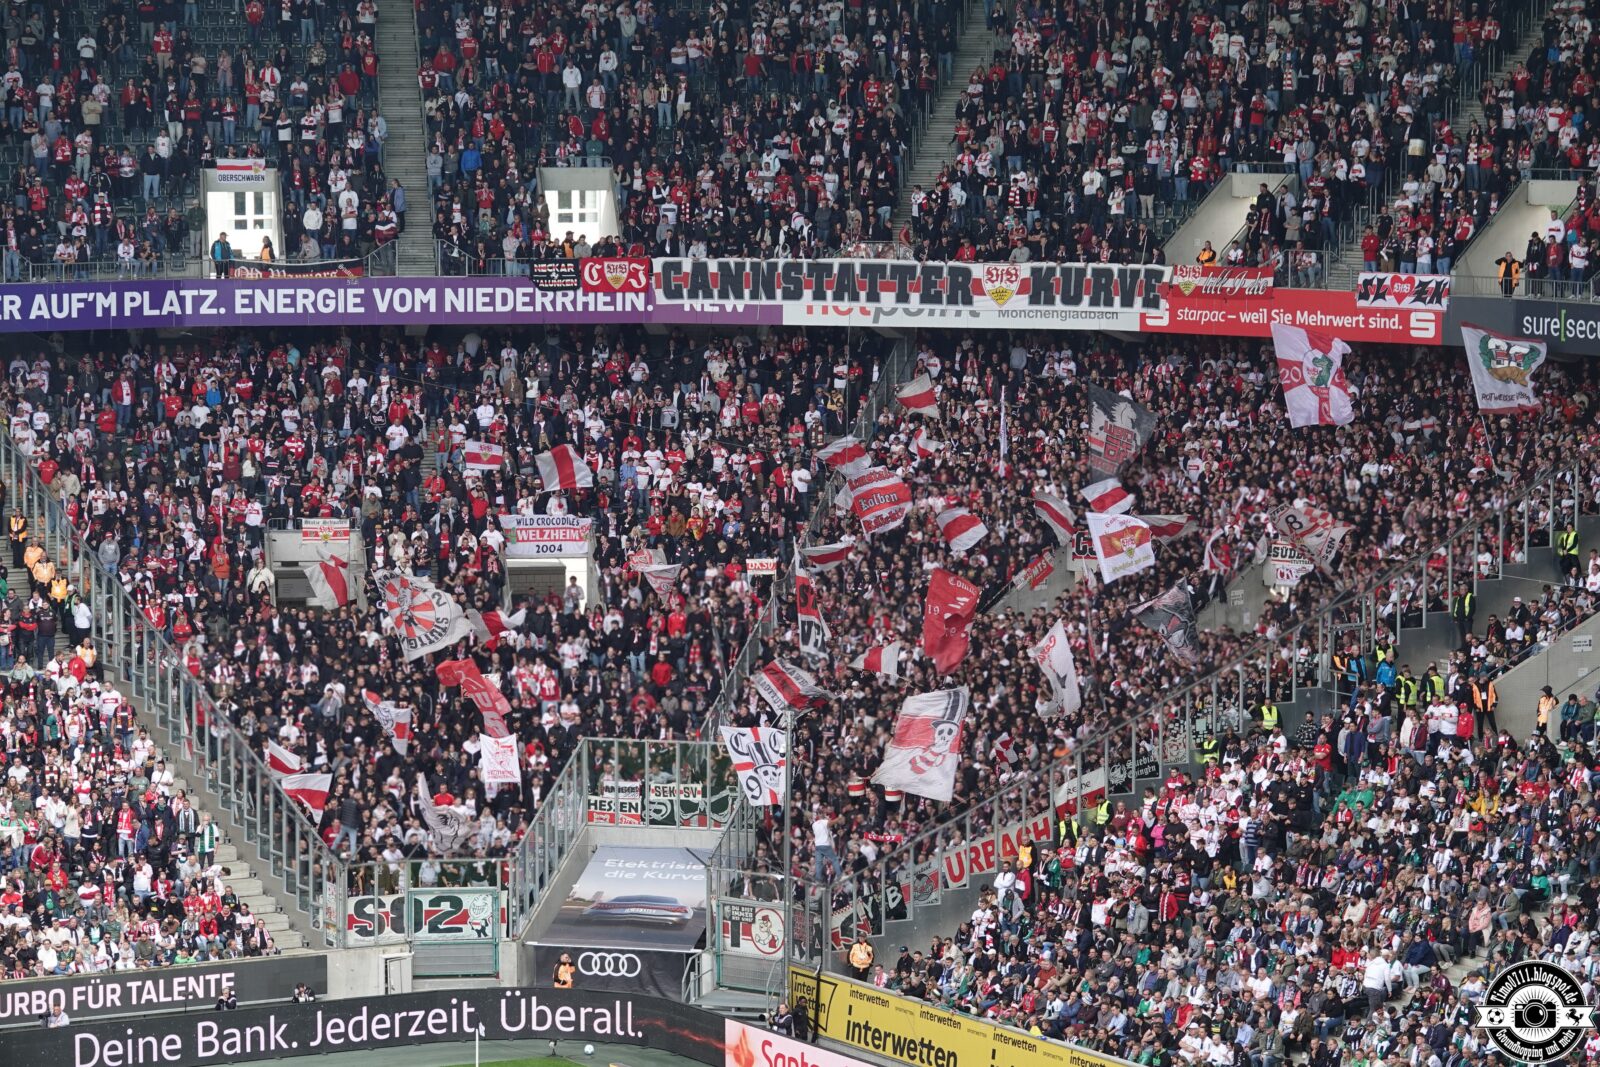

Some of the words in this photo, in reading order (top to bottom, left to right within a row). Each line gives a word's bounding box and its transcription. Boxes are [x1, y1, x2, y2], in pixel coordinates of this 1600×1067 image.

[218, 174, 265, 182] OBERSCHWABEN
[533, 263, 575, 273] NECKAR
[533, 278, 578, 288] ALUNKEN
[661, 260, 974, 306] CANNSTATTER
[984, 265, 1019, 284] VfB
[1028, 265, 1166, 310] KURVE
[0, 299, 22, 320] R
[123, 288, 226, 317] PLATZ.
[234, 287, 365, 314] ENERGIE
[373, 287, 437, 313] VOM
[444, 286, 654, 313] NIEDERRHEIN.
[1176, 307, 1226, 325] starpac
[1239, 308, 1268, 324] weil
[1270, 309, 1293, 325] Sie
[1296, 310, 1365, 328] Mehrwert
[1368, 314, 1403, 330] sind.
[516, 517, 535, 526] WILD
[536, 516, 580, 527] CROCODILES
[516, 529, 580, 541] WELZHEIM
[535, 543, 563, 554] 2004
[654, 785, 675, 798] SEK
[683, 786, 698, 798] SV
[587, 799, 639, 813] HESEN
[604, 870, 637, 879] die
[642, 870, 706, 881] Kurve
[81, 980, 121, 1009] FÜR
[129, 972, 236, 1005] TALENTE
[793, 974, 816, 996] inter
[849, 984, 890, 1009] interwetten
[75, 1028, 182, 1067] Deine
[197, 1014, 299, 1058] Bank.
[500, 990, 643, 1039] Überall.
[919, 1005, 962, 1031] interwetten
[845, 1005, 958, 1067] interwetten
[993, 1027, 1037, 1054] interwetten
